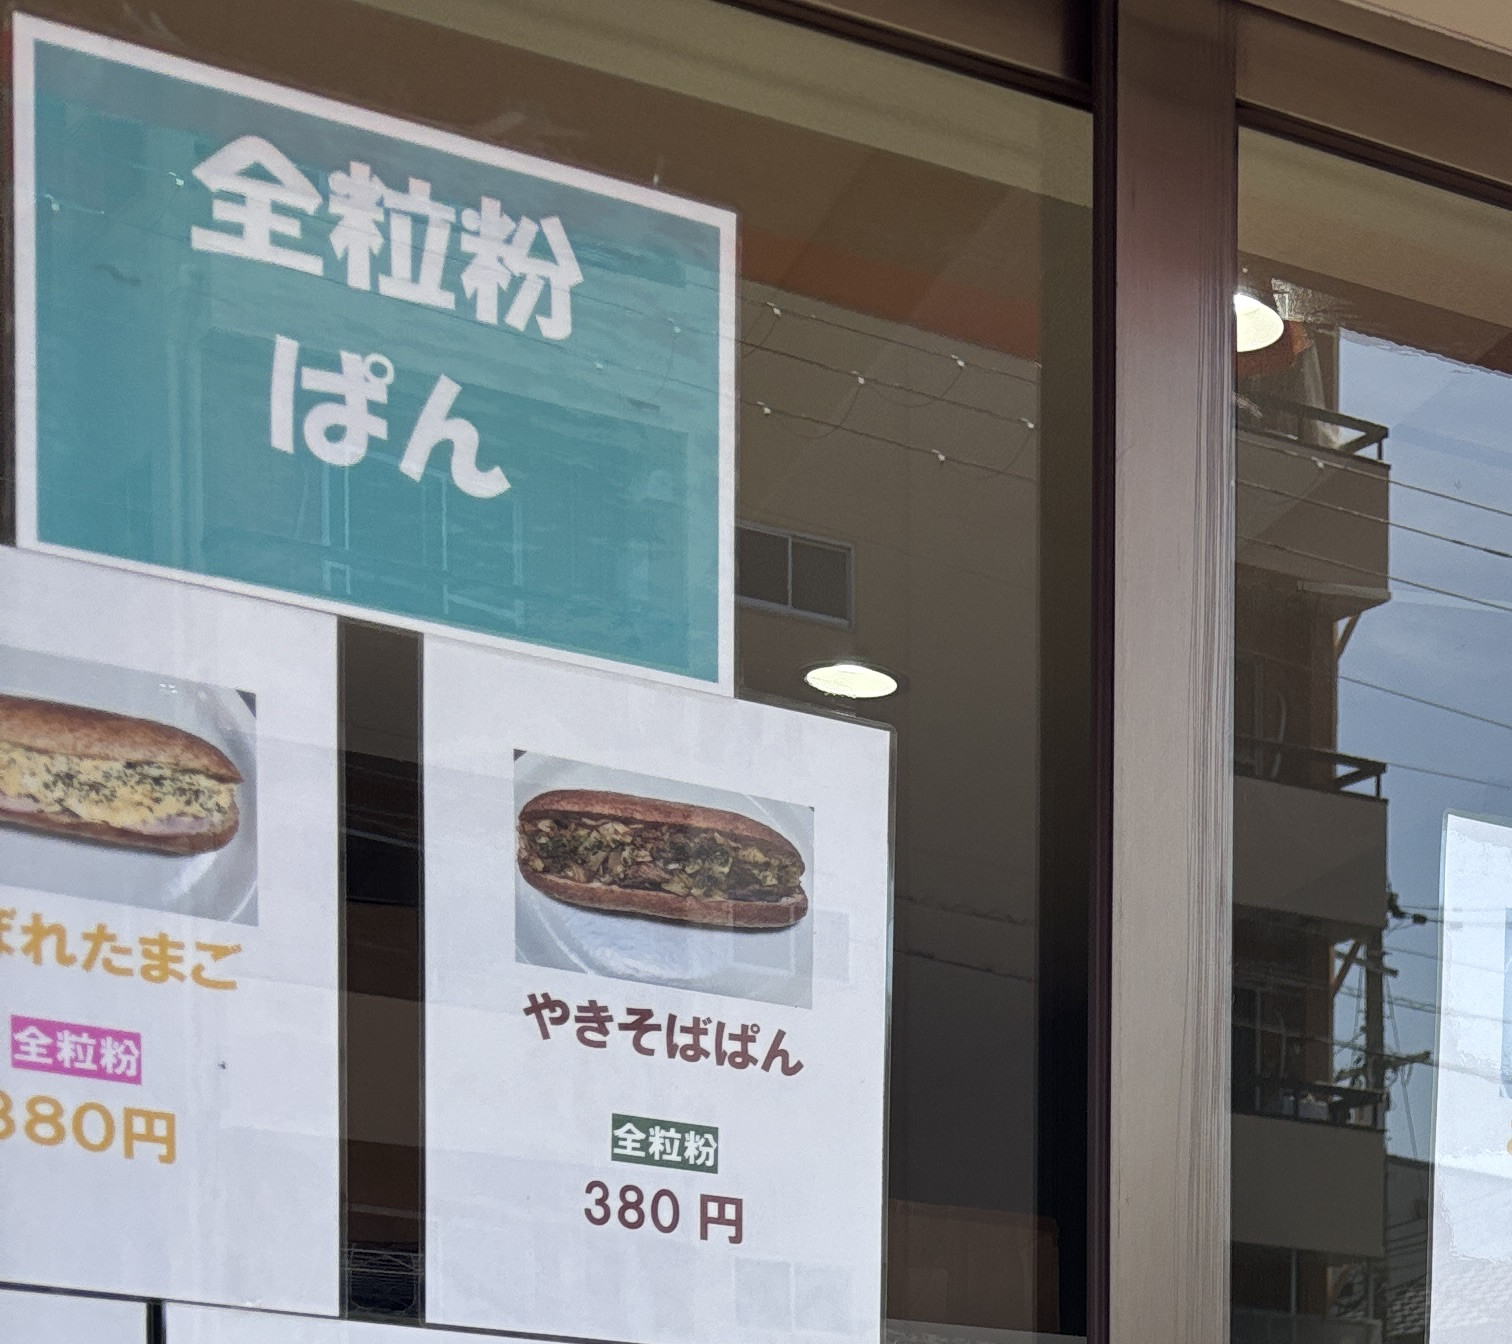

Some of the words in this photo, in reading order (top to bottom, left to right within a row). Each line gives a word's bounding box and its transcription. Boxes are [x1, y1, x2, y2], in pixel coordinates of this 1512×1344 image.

[191, 136, 584, 340] 全粒粉
[270, 335, 512, 499] ぱん
[14, 1026, 139, 1076] 全粒粉
[524, 992, 804, 1077] やきそばぱん
[612, 1123, 718, 1170] 全粒粉
